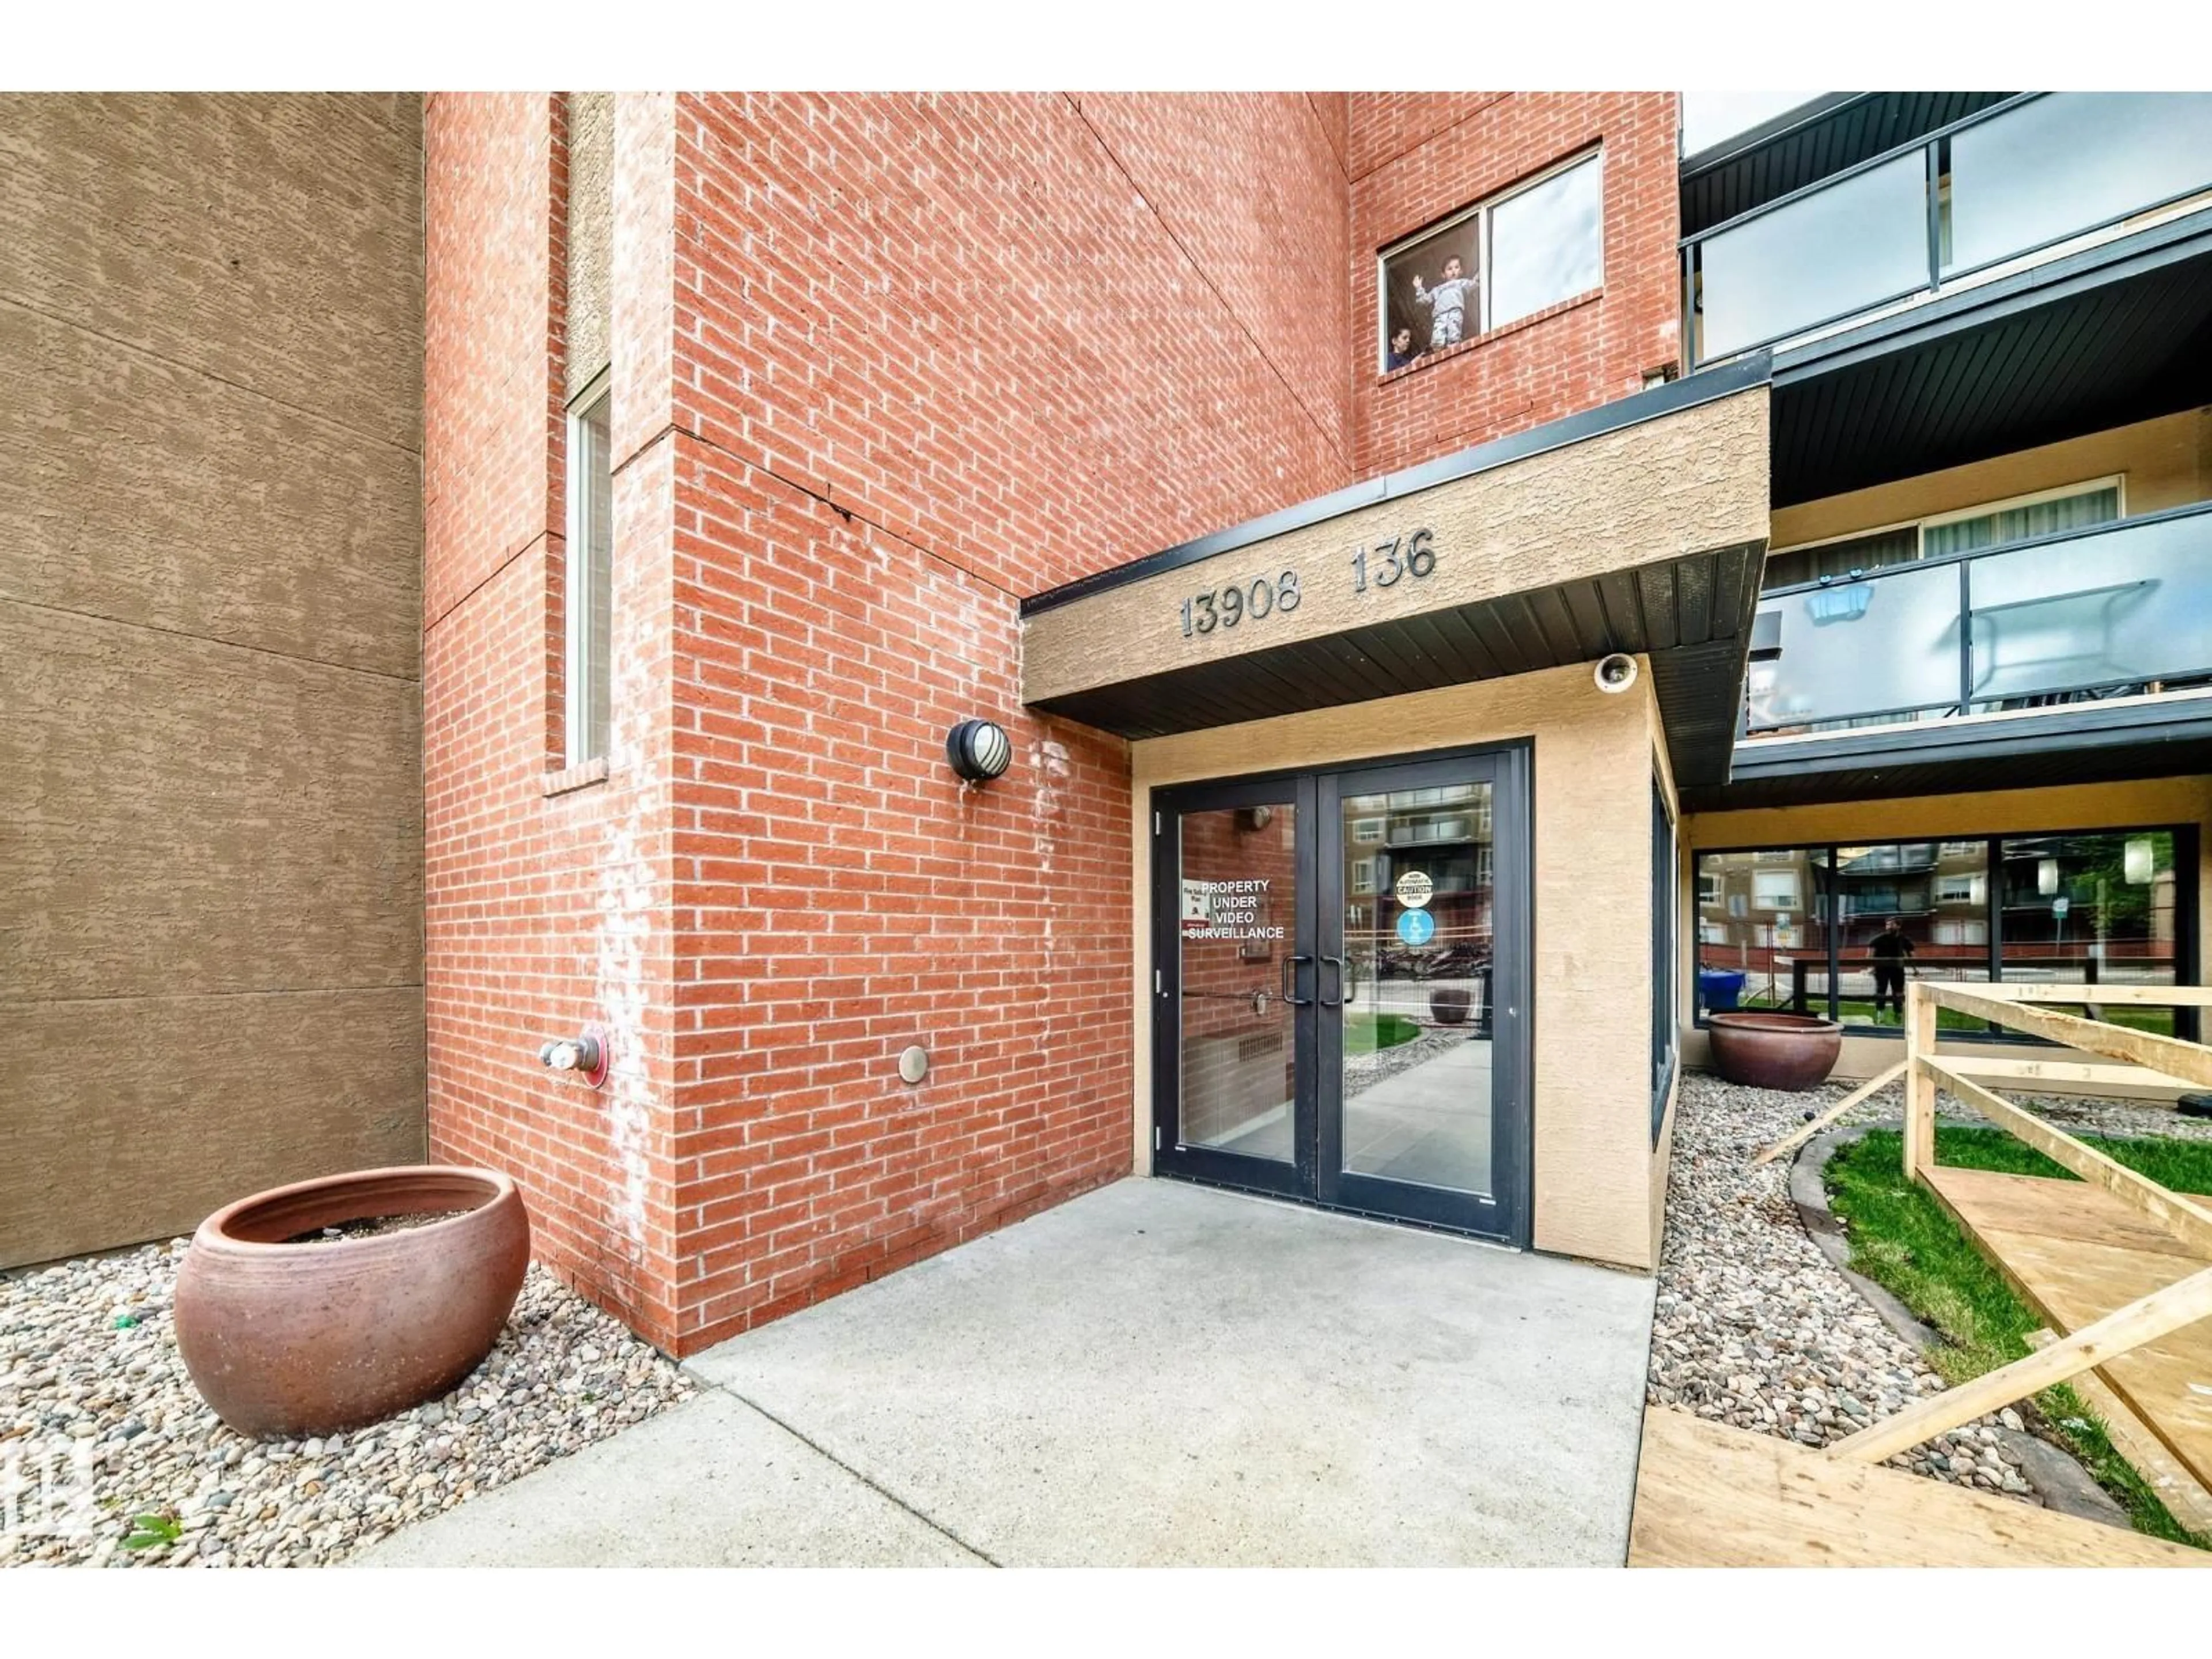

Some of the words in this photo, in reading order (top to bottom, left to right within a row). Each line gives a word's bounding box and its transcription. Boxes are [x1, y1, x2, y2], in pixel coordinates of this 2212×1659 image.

[1180, 570, 1301, 637] 13908
[1351, 528, 1436, 593] 136
[1202, 880, 1270, 893] PROPERTY
[1397, 886, 1431, 894] CAUTION
[1213, 896, 1257, 908] UNDER
[1215, 912, 1255, 923] VIDEO
[1188, 927, 1284, 939] SURVEILLANCE
